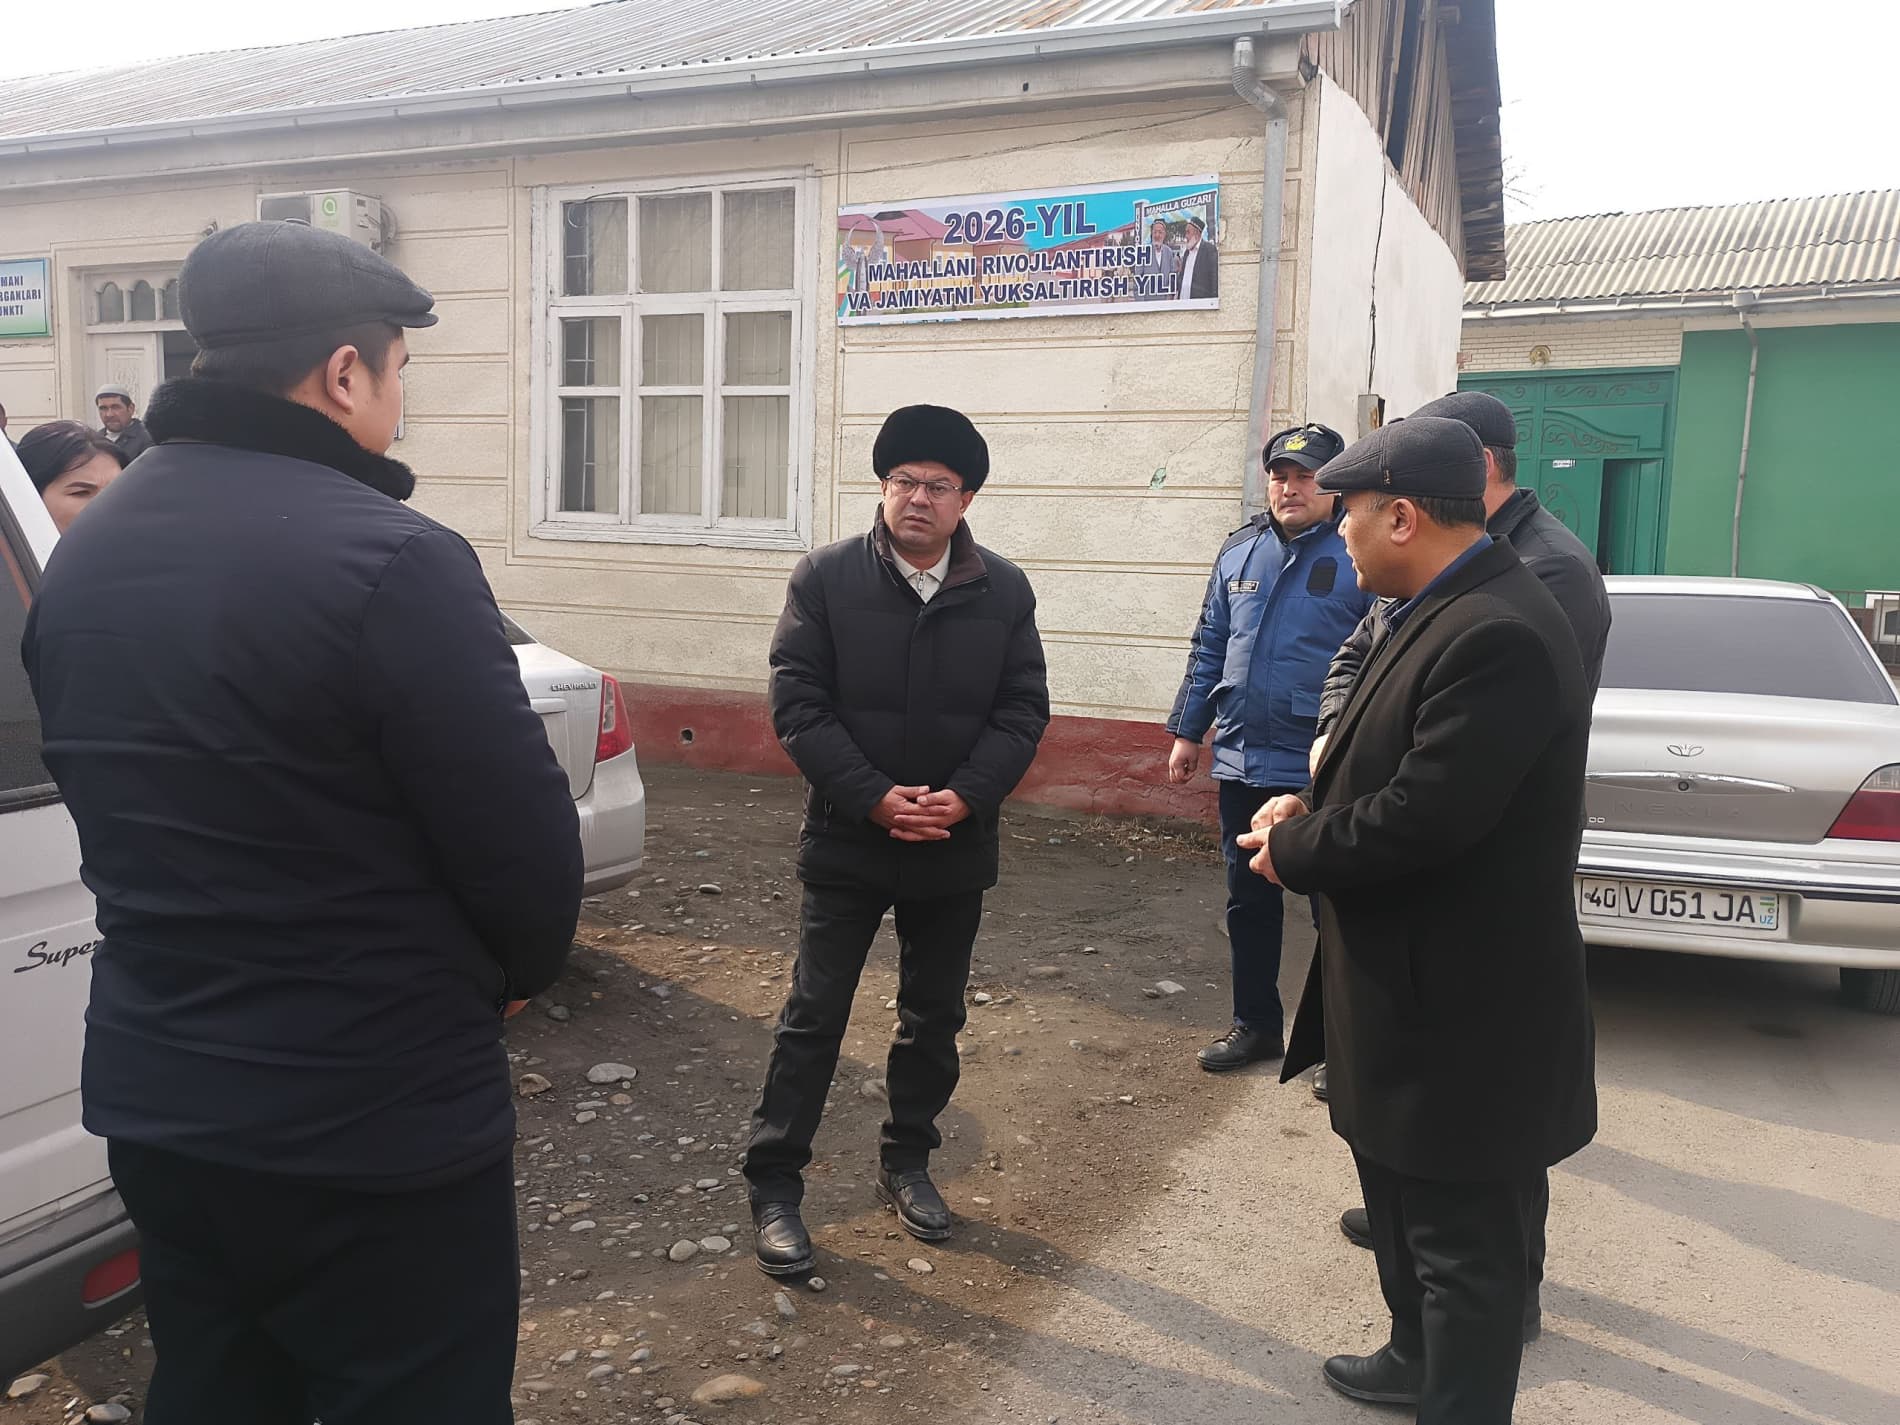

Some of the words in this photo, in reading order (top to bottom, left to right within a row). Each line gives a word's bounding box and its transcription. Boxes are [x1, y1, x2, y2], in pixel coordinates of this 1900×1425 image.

[1145, 200, 1180, 216] MAHALLA
[1180, 193, 1212, 208] GUZARI
[943, 202, 1096, 244] 2026-YIL
[868, 256, 976, 282] MAHALLANI
[983, 245, 1152, 274] RIVOJLANTIRISH
[847, 292, 871, 310] VA
[876, 286, 975, 309] JAMIYATNI
[981, 277, 1128, 303] YUKSALTIRISH
[1135, 274, 1176, 295] YILI
[1589, 887, 1616, 908] 40
[1625, 886, 1643, 914] V
[1650, 888, 1706, 920] 051
[1713, 893, 1756, 923] JA
[1759, 915, 1774, 925] UZ
